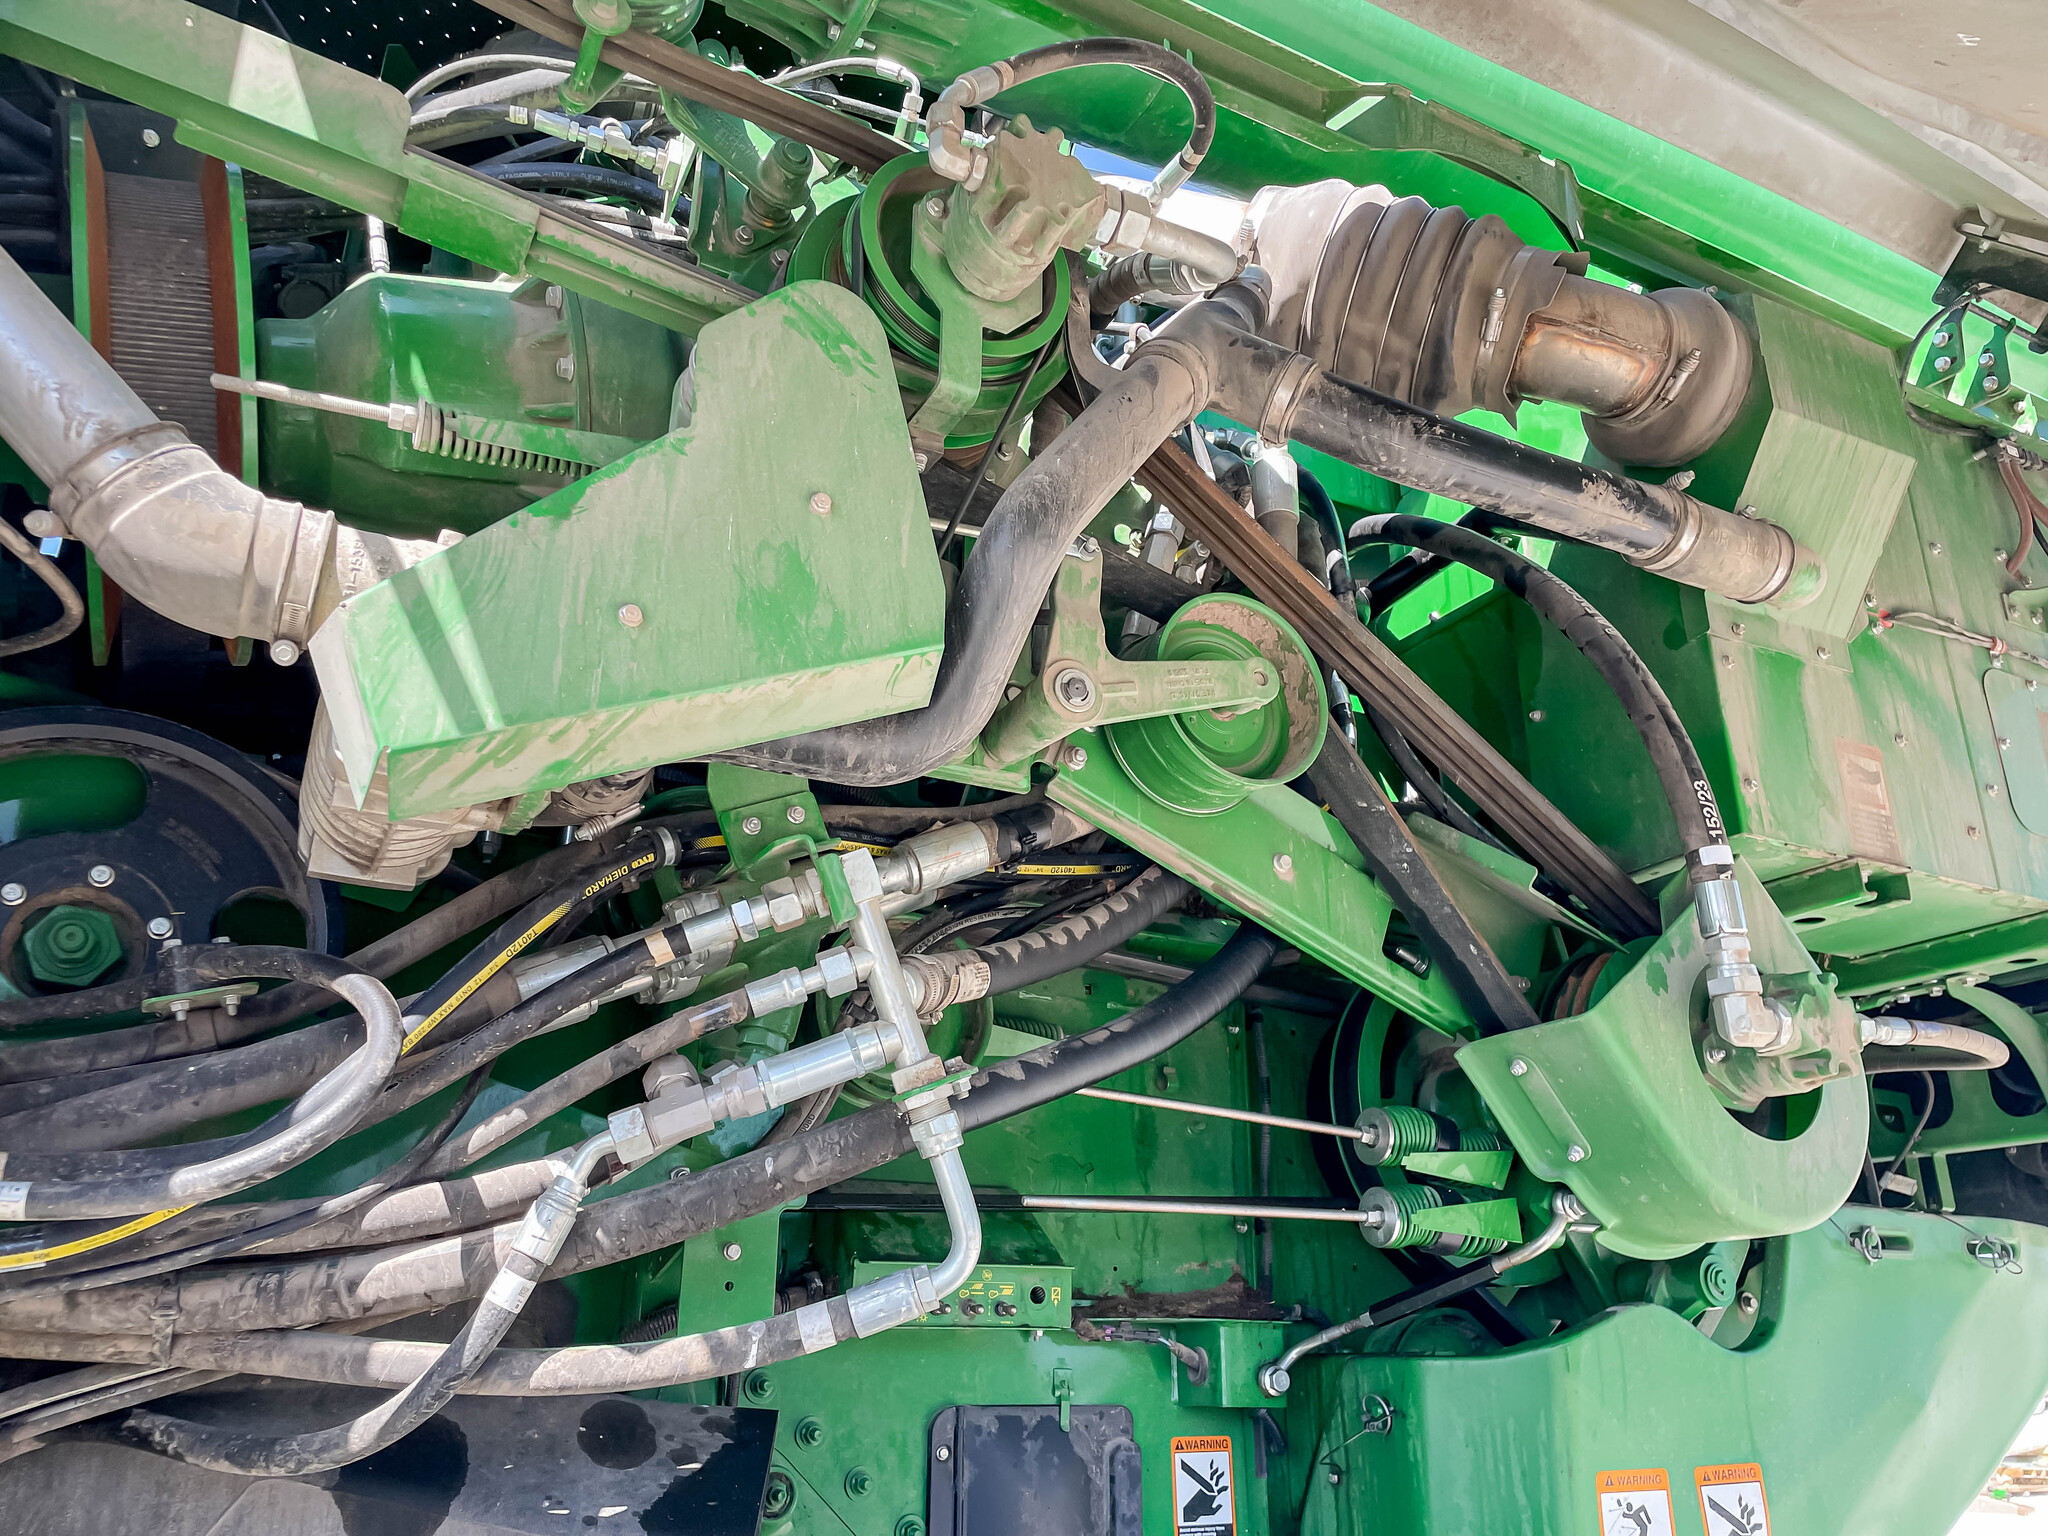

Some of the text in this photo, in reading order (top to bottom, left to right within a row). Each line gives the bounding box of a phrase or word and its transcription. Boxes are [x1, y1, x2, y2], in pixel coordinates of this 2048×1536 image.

[1050, 866, 1076, 874] T4012D
[965, 911, 1001, 924] RESISTANT
[506, 928, 539, 958] T4012D
[438, 1003, 454, 1018] MAX
[1185, 1439, 1229, 1450] WARNING
[1617, 1474, 1662, 1486] WARNING
[1712, 1467, 1757, 1480] WARNING
